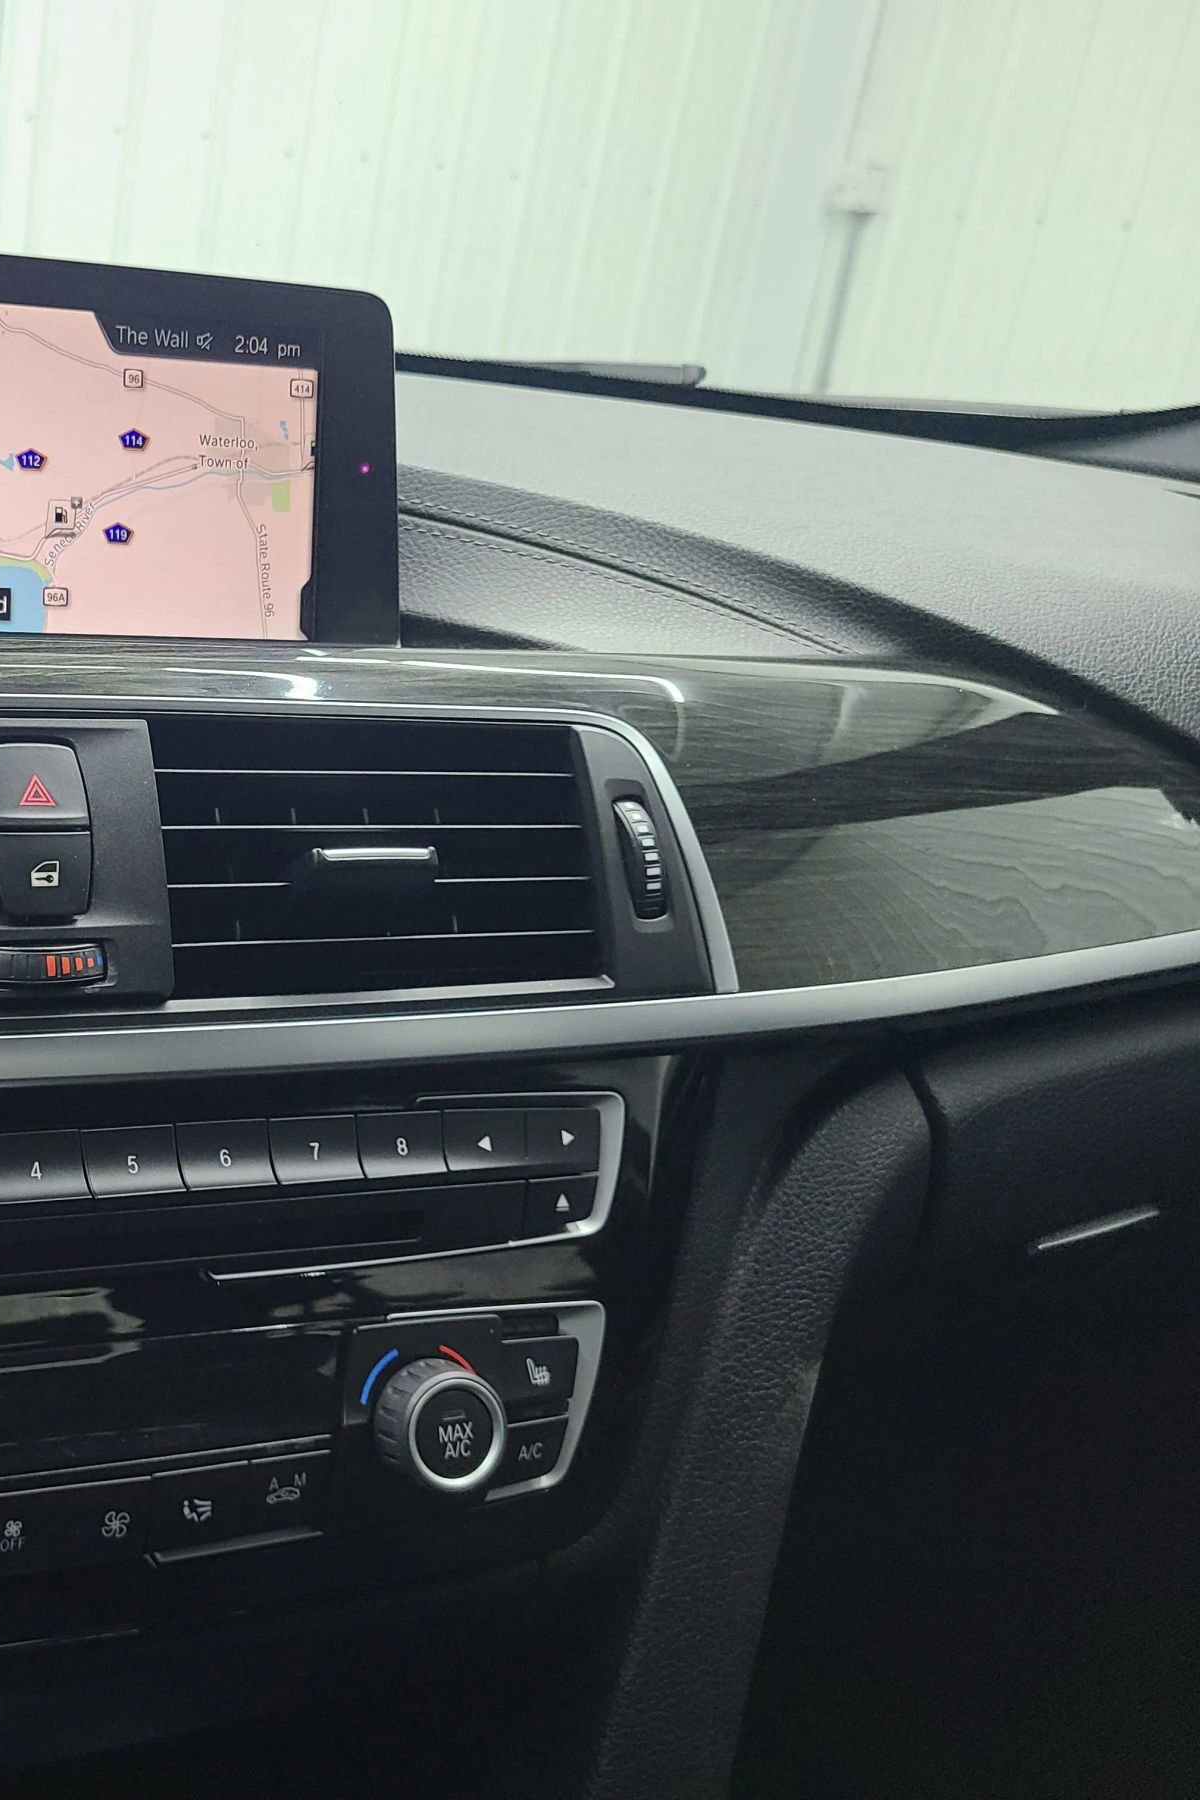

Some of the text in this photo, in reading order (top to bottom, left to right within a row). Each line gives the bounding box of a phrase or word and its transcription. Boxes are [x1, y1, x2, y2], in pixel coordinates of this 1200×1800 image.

[115, 325, 189, 349] The Wall
[234, 335, 301, 360] 2:04 pm
[128, 373, 140, 385] 96
[294, 383, 310, 395] 414
[124, 434, 143, 448] 114
[199, 434, 258, 452] Waterloo,
[21, 454, 41, 468] 112
[198, 454, 249, 470] Town of
[44, 502, 96, 567] Seneca River
[107, 528, 128, 542] 119
[255, 523, 275, 618] State Route 96
[46, 592, 66, 603] 96A
[309, 1142, 321, 1161] 7
[395, 1137, 408, 1156] 8
[126, 1154, 139, 1175] 5
[219, 1148, 232, 1168] 6
[30, 1161, 42, 1181] 4
[438, 1421, 474, 1443] MAX
[444, 1439, 471, 1460] A/C
[517, 1442, 543, 1460] A/C
[0, 1536, 26, 1553] OFF
